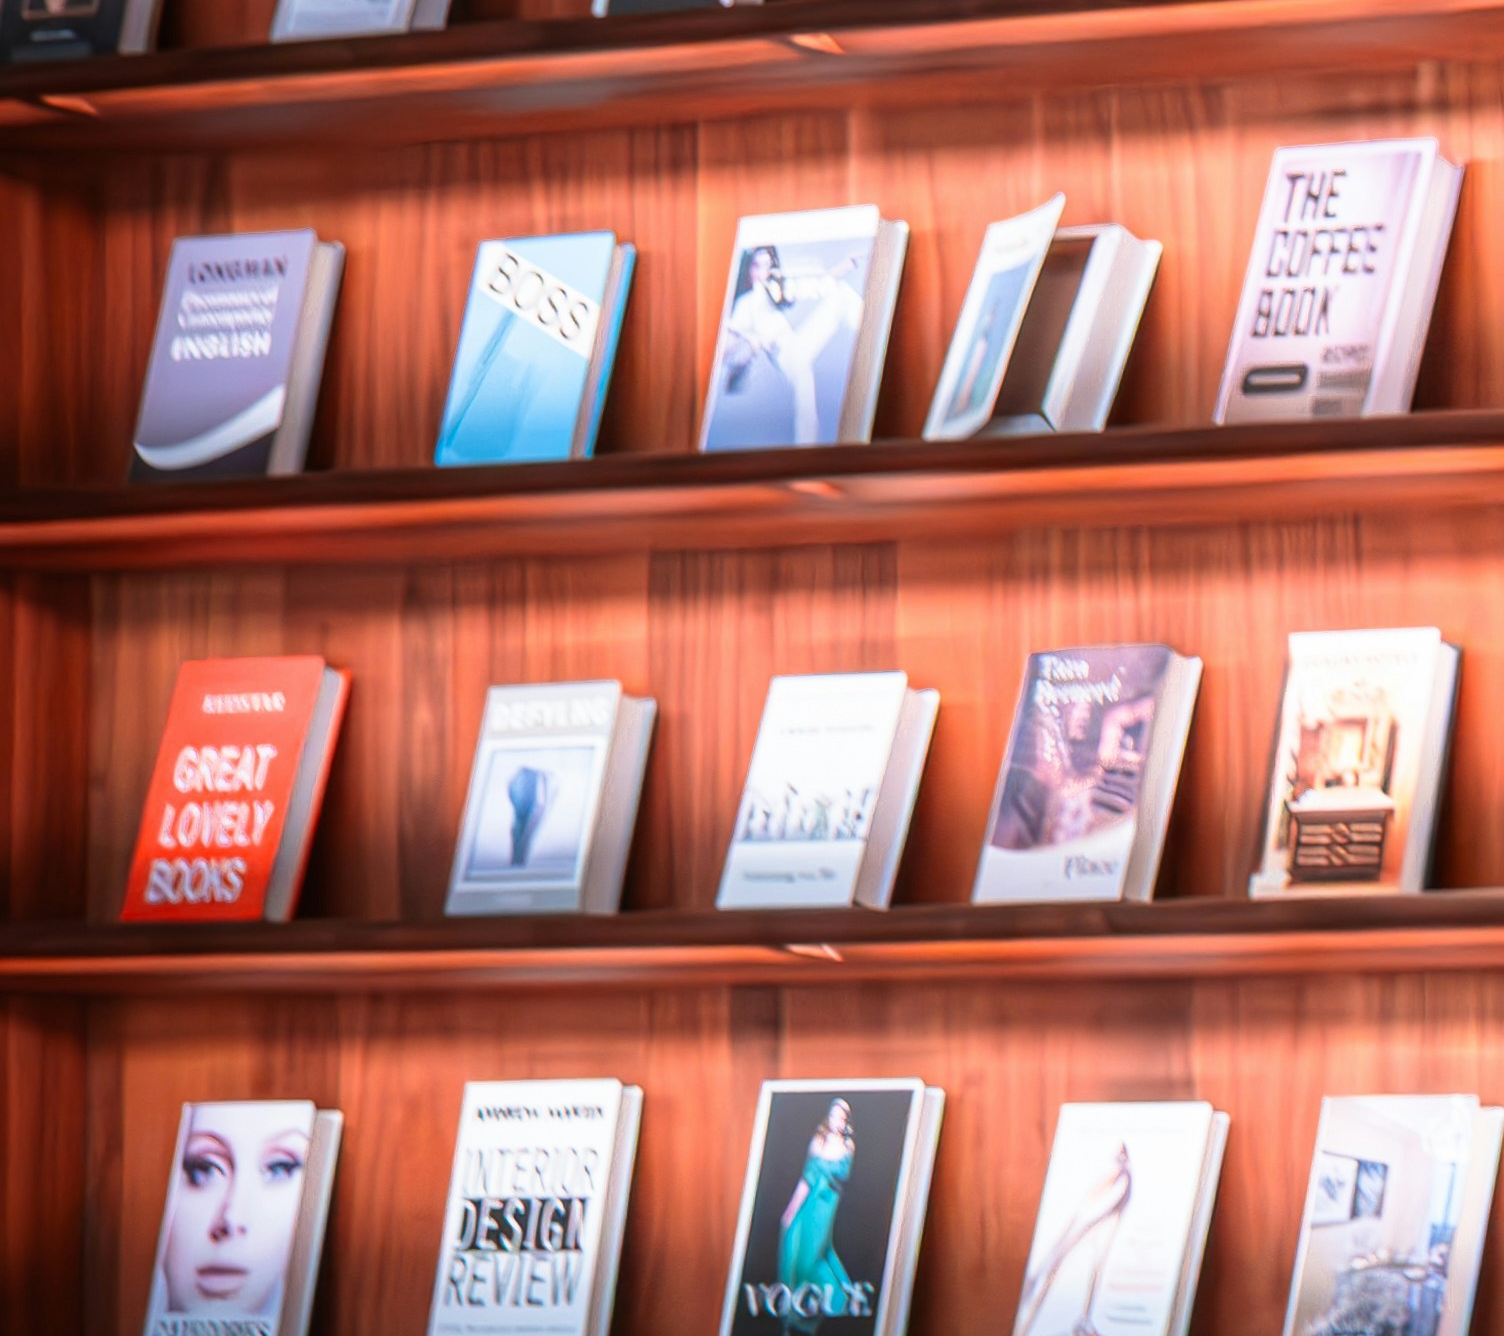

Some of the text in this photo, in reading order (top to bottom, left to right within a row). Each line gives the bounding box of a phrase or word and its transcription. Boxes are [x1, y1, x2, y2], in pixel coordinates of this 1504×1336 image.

[1284, 169, 1348, 223] THE
[1266, 223, 1385, 279] COFFEE
[488, 252, 590, 340] BOSS
[1250, 284, 1340, 339] BOOK
[171, 331, 272, 362] ENGLISH
[173, 743, 279, 793] GREAT
[158, 799, 275, 849] LOVELY
[144, 857, 247, 905] BOOKS
[463, 1147, 600, 1195] INTERIOR
[453, 1197, 590, 1253] DESIGN
[443, 1253, 585, 1308] REVIEW
[744, 1281, 876, 1318] VOGUE
